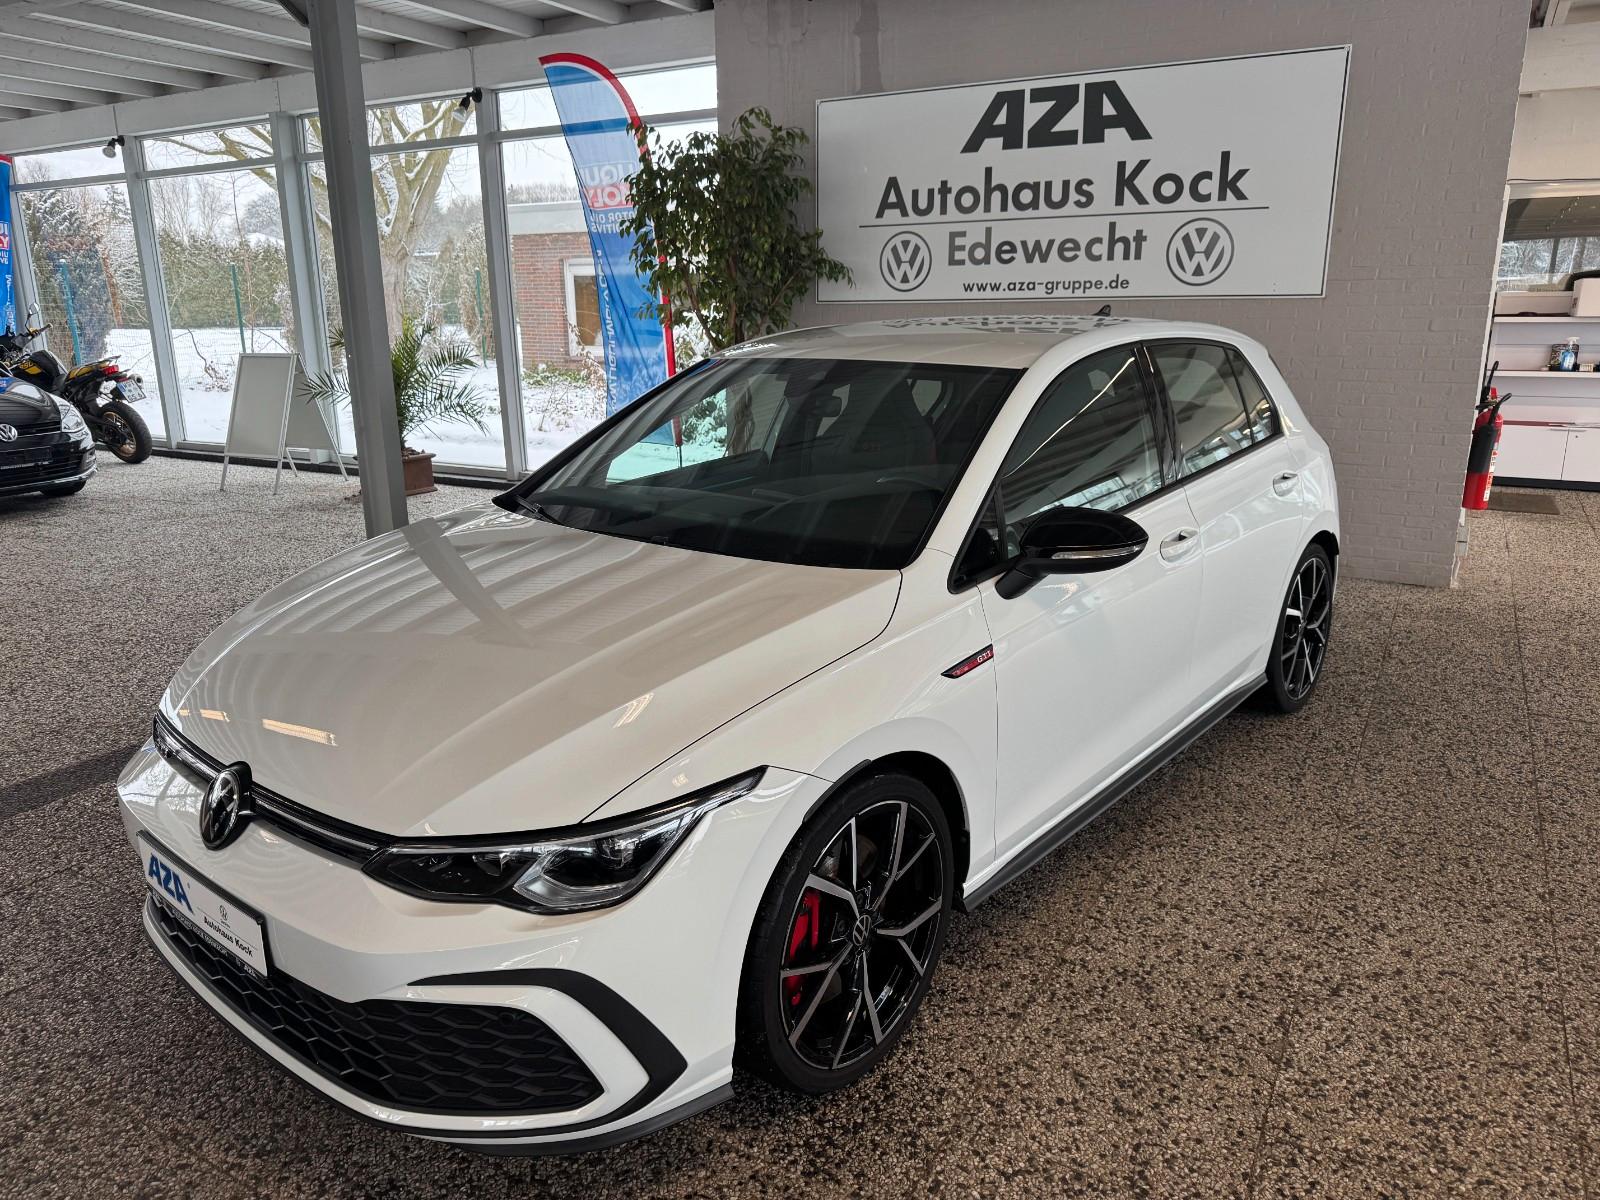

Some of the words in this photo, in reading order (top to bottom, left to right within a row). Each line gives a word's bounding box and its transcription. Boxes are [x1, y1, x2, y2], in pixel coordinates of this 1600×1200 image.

[959, 79, 1153, 155] AZA
[874, 166, 1095, 220] Autohaus
[1114, 150, 1252, 207] Kock
[947, 221, 1148, 267] Edewecht
[962, 273, 1130, 296] www.aza-gruppe.de
[149, 853, 194, 914] AZA
[203, 916, 235, 944] Autohaus
